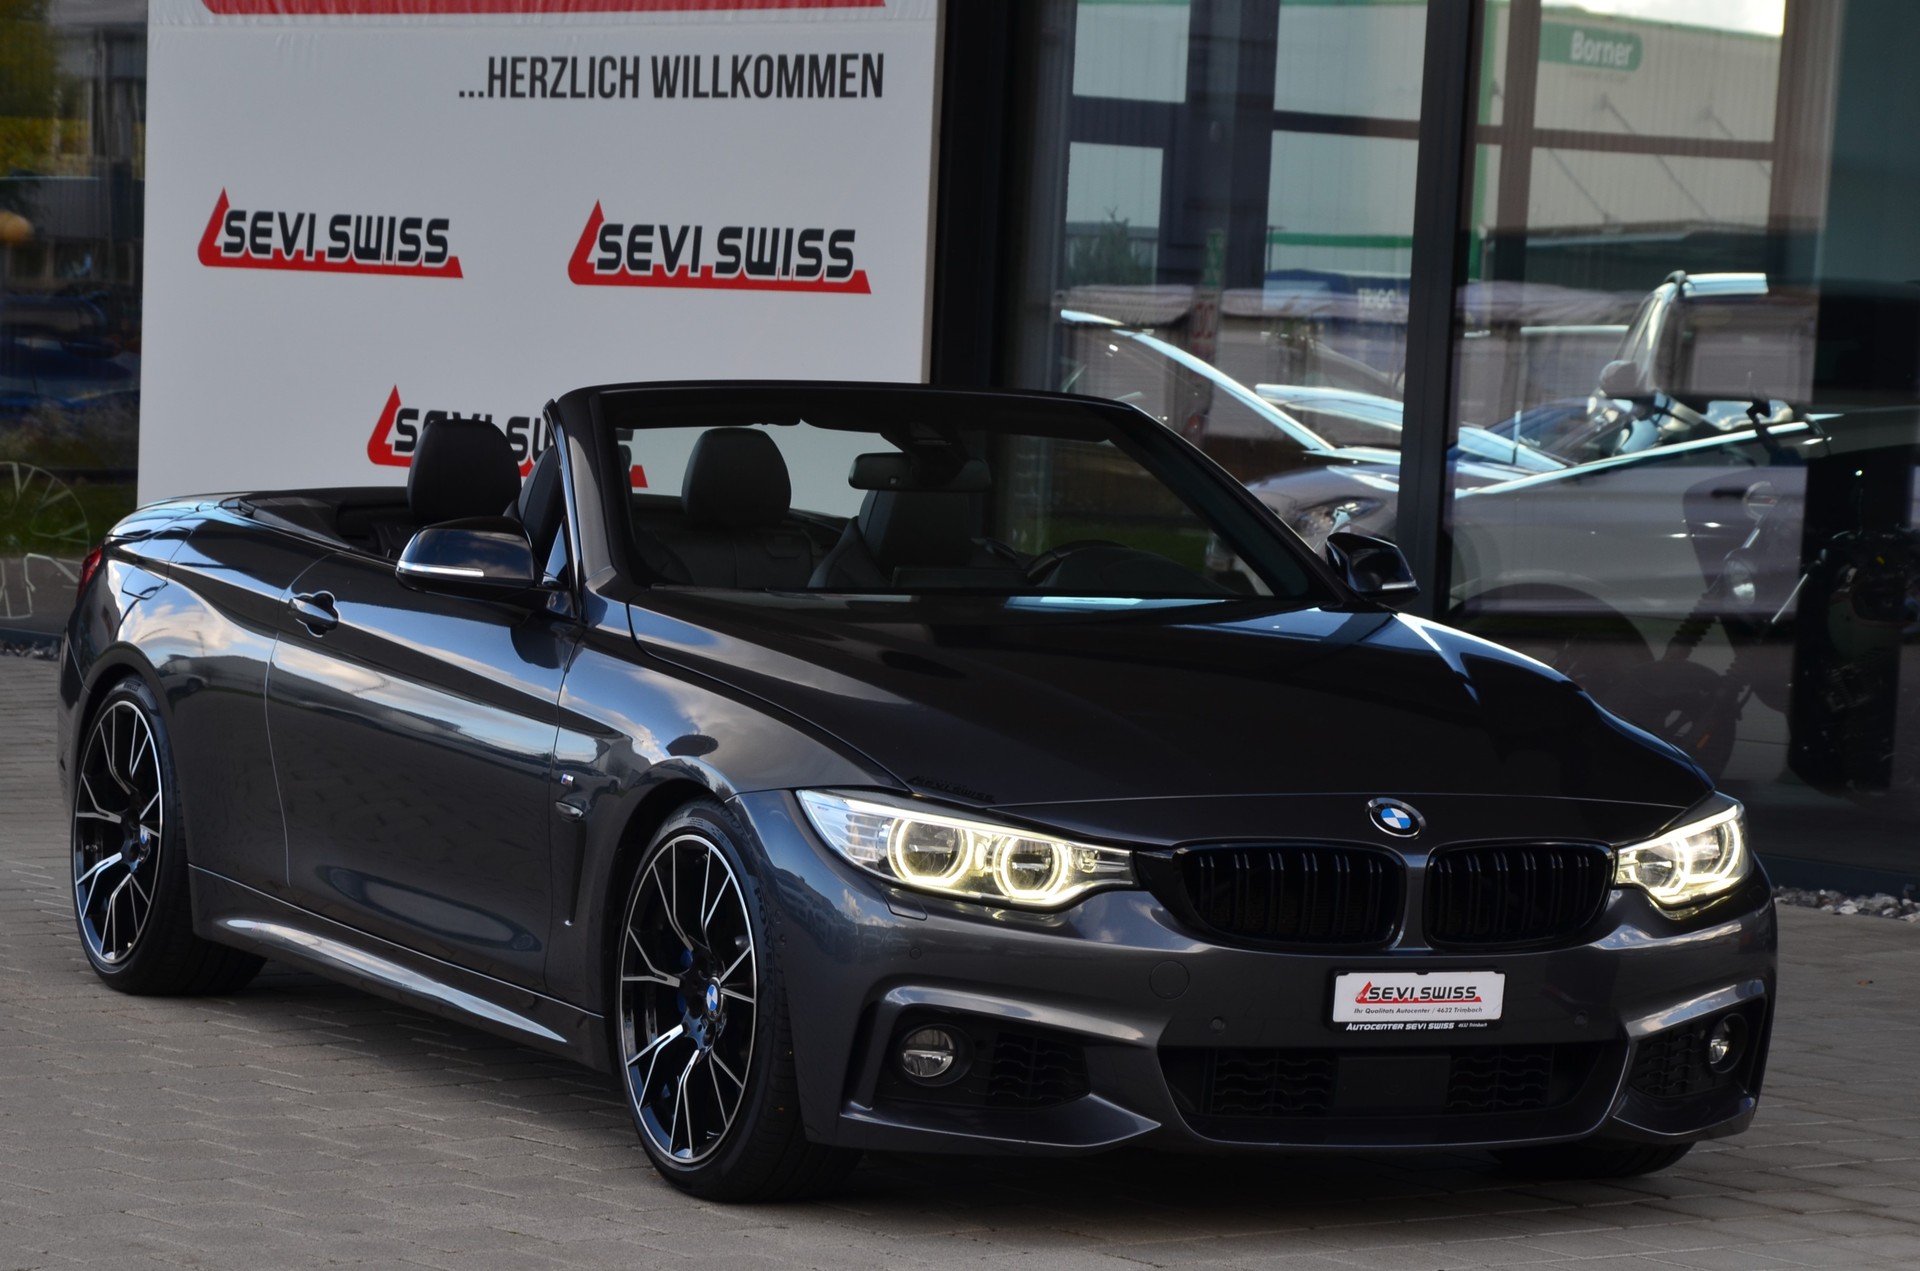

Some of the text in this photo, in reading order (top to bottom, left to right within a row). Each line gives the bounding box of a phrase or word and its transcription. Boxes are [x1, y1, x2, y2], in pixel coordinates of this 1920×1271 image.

[650, 53, 884, 98] WILLKOMMEN
[223, 209, 450, 264] SEVI SWISS
[597, 223, 856, 279] SEVI SWISS
[1368, 986, 1477, 1000] SEVI SWISS
[1405, 1022, 1427, 1030] SEVI
[1428, 1022, 1455, 1030] SWISS
